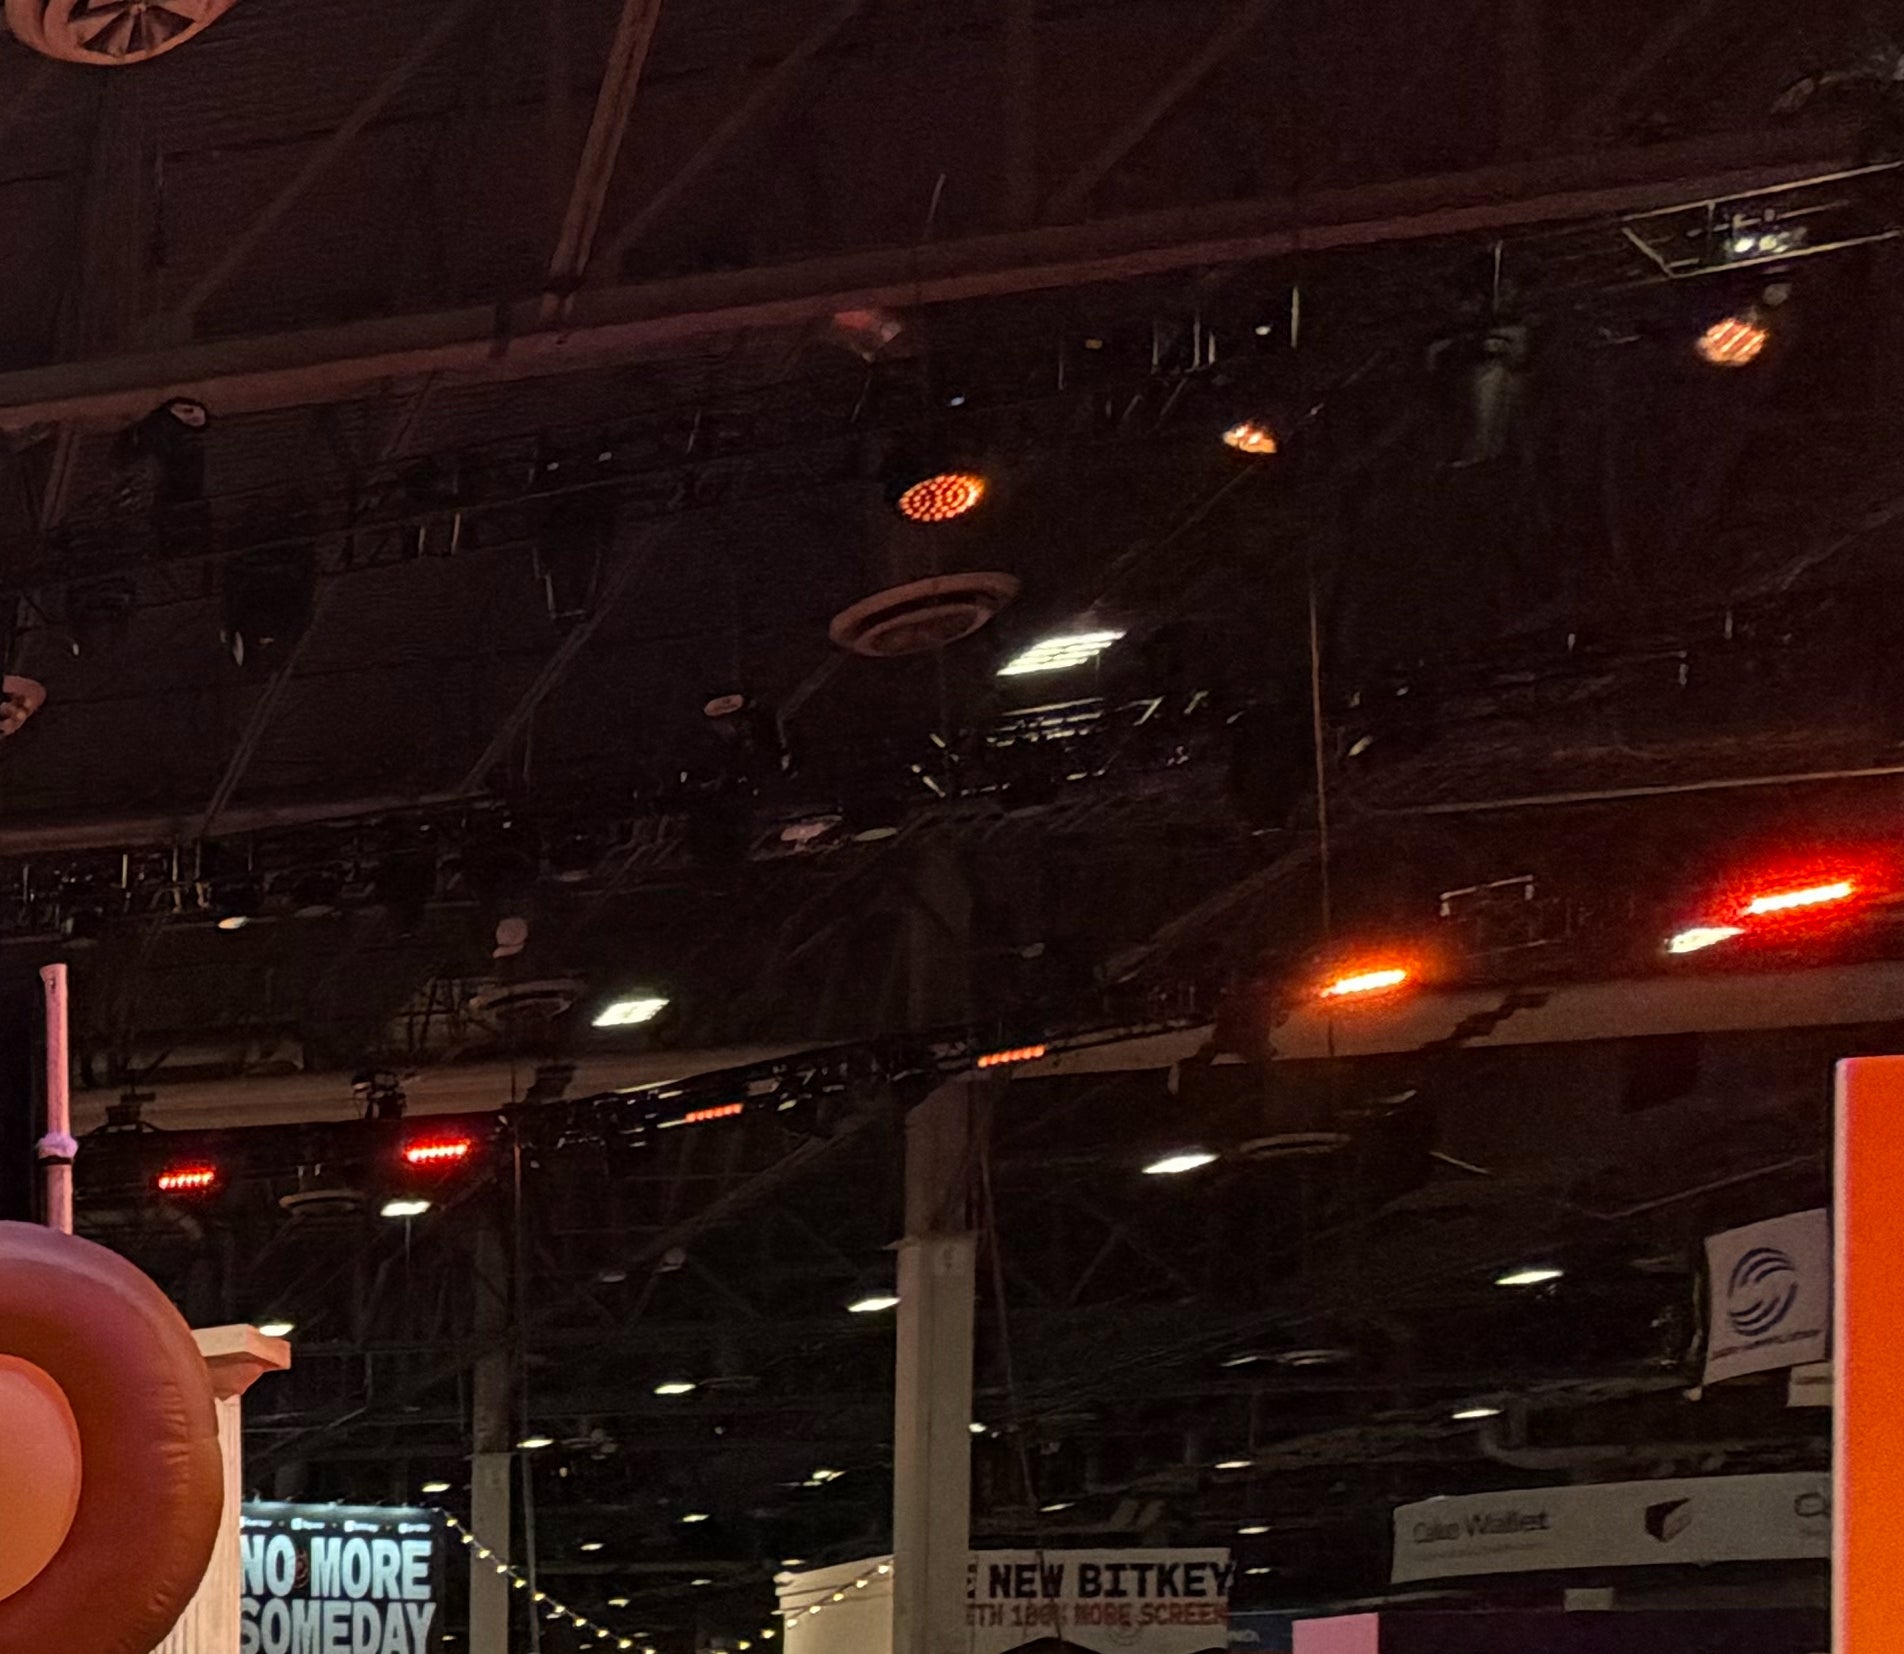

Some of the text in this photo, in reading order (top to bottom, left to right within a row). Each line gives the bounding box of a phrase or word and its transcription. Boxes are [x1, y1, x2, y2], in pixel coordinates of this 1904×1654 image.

[240, 1534, 432, 1600] NO MORE
[989, 1562, 1064, 1599] NEW
[1078, 1561, 1233, 1599] BITKEY
